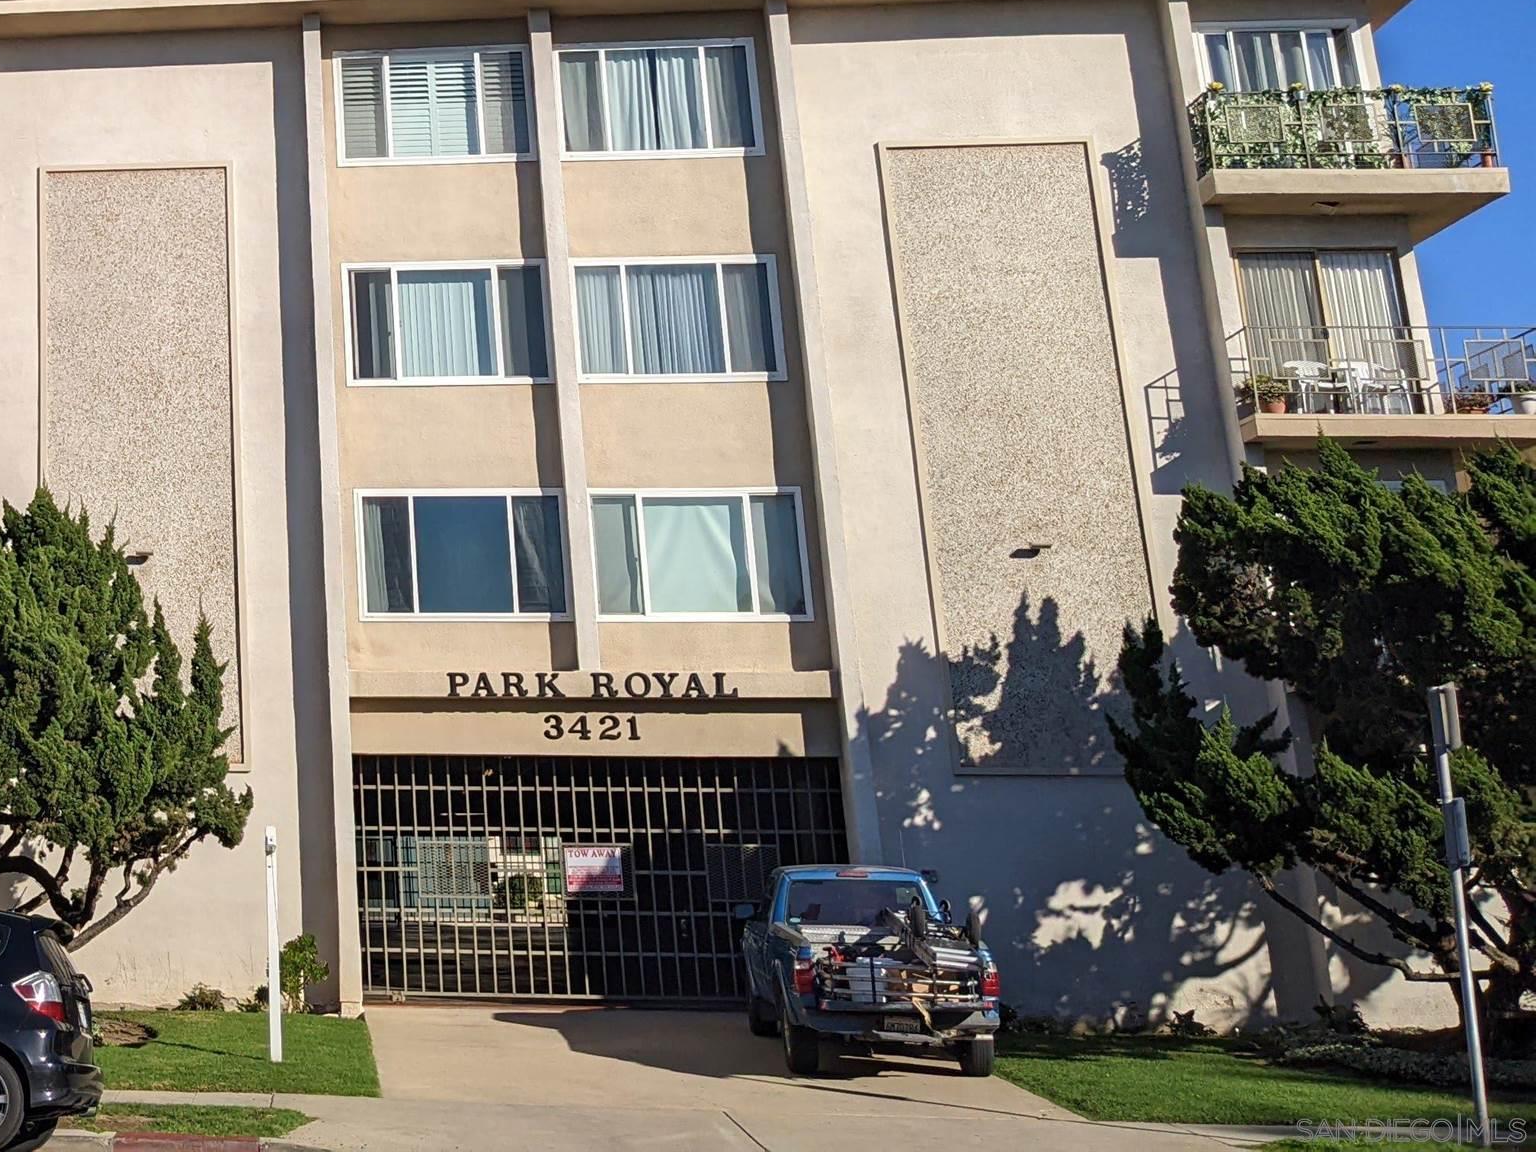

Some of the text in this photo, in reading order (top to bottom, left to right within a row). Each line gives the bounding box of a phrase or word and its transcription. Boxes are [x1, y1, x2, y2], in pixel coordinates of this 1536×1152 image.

[446, 672, 739, 698] PARK ROYAL
[543, 714, 641, 741] 3421
[567, 849, 616, 858] TOW AWAY
